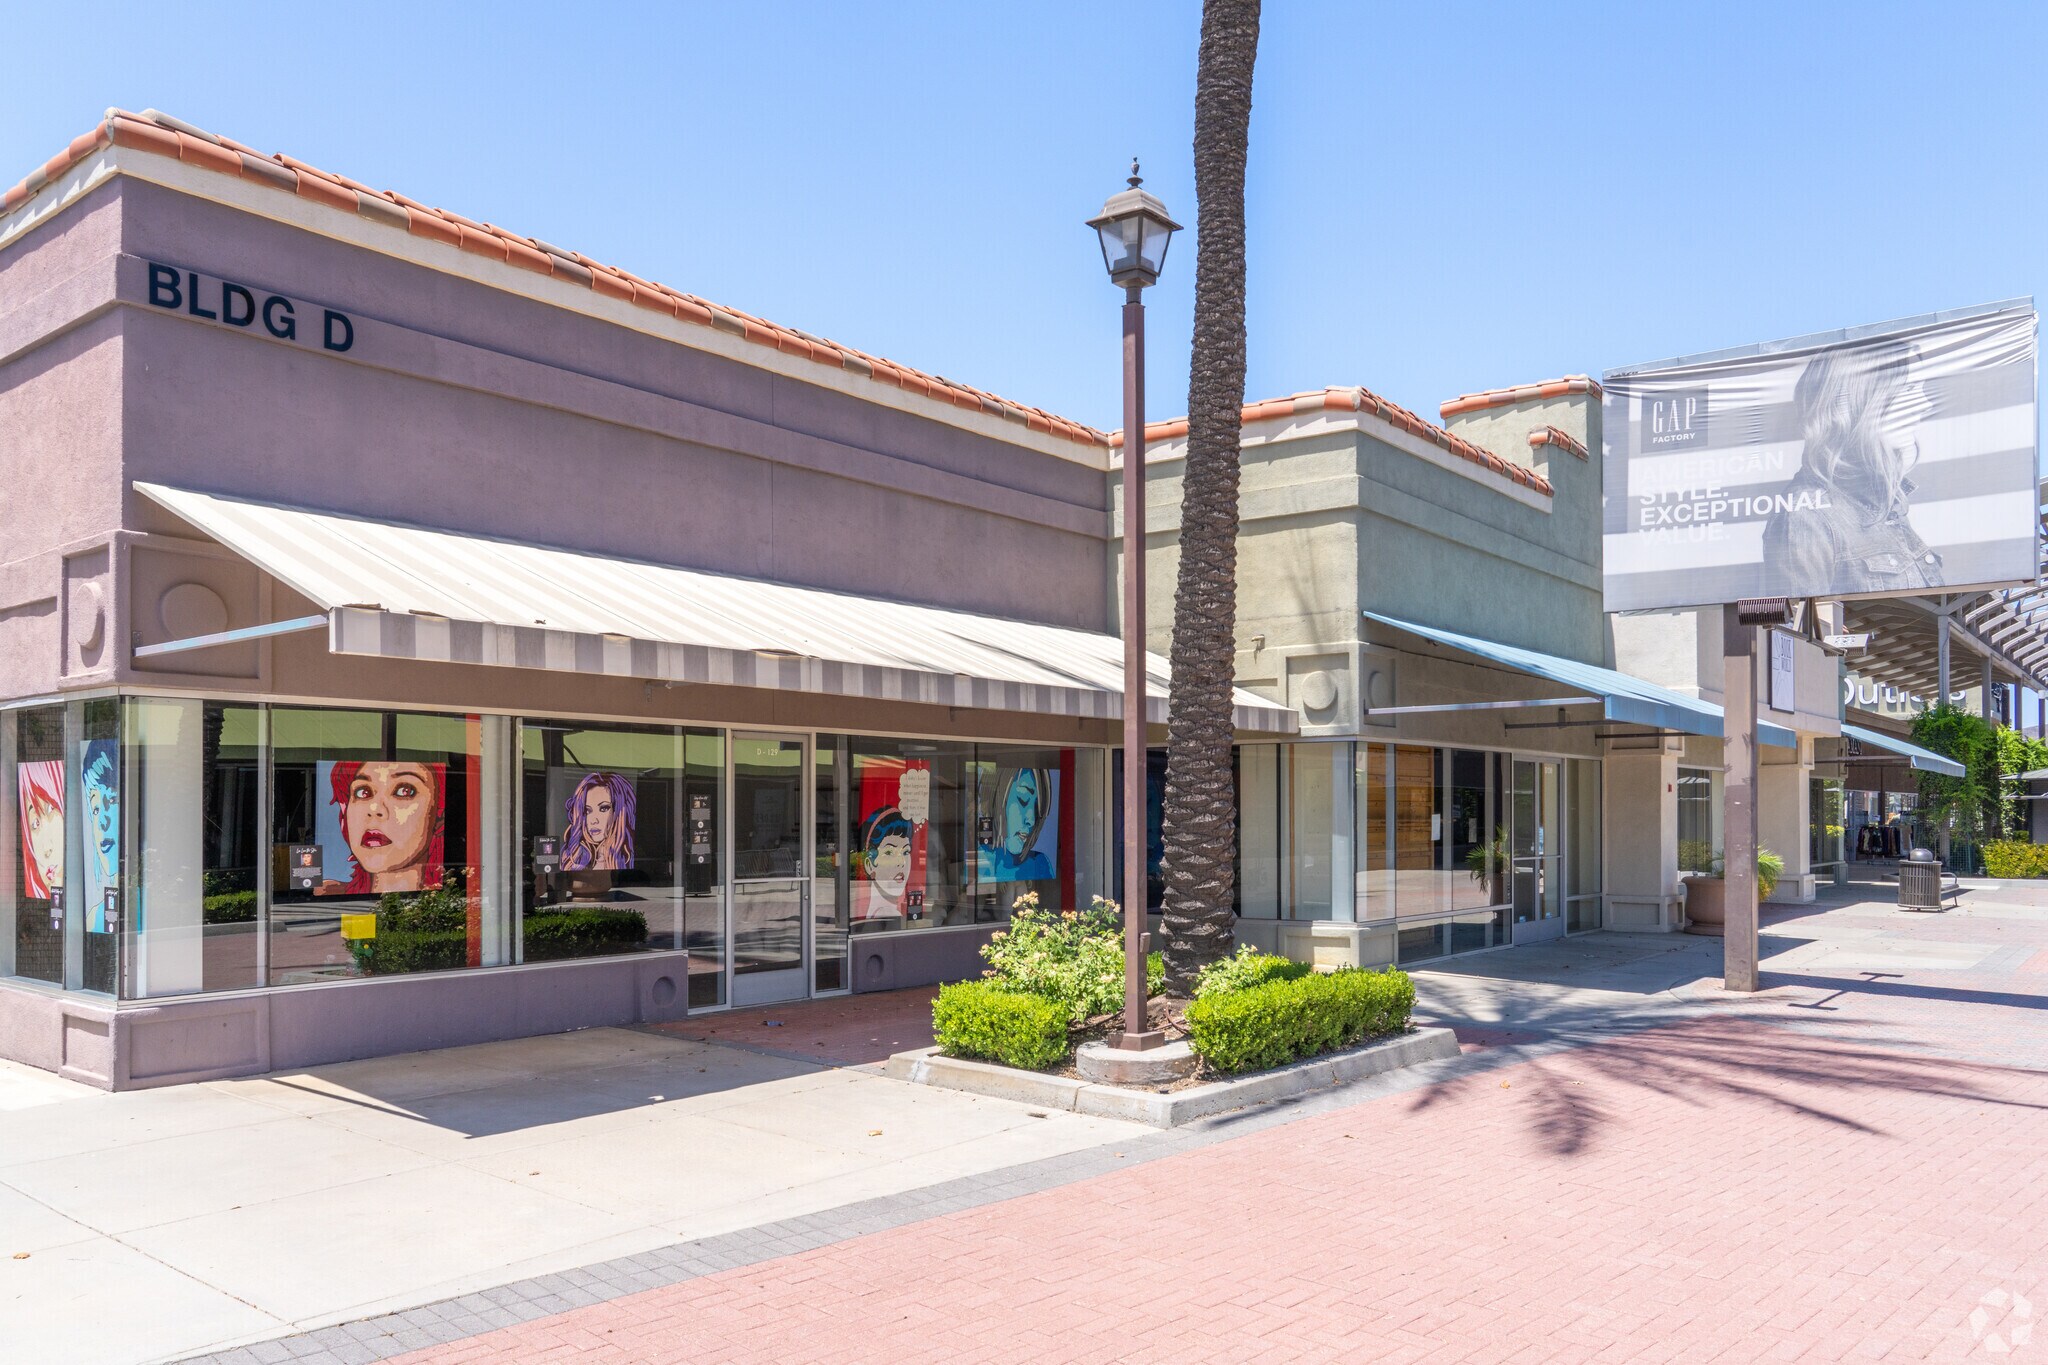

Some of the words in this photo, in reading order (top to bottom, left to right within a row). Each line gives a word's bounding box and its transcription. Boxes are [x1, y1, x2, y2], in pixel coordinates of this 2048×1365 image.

[149, 262, 296, 341] BLDG
[324, 310, 354, 352] D
[1652, 397, 1696, 433] GAP
[1652, 432, 1696, 444] FACTORY
[1640, 450, 1784, 482] AMERICAN
[1640, 480, 1728, 505] STYLE.
[1640, 490, 1832, 526] EXCEPTIONAL
[1639, 522, 1731, 548] VALUE.
[1844, 677, 1966, 705] Outs
